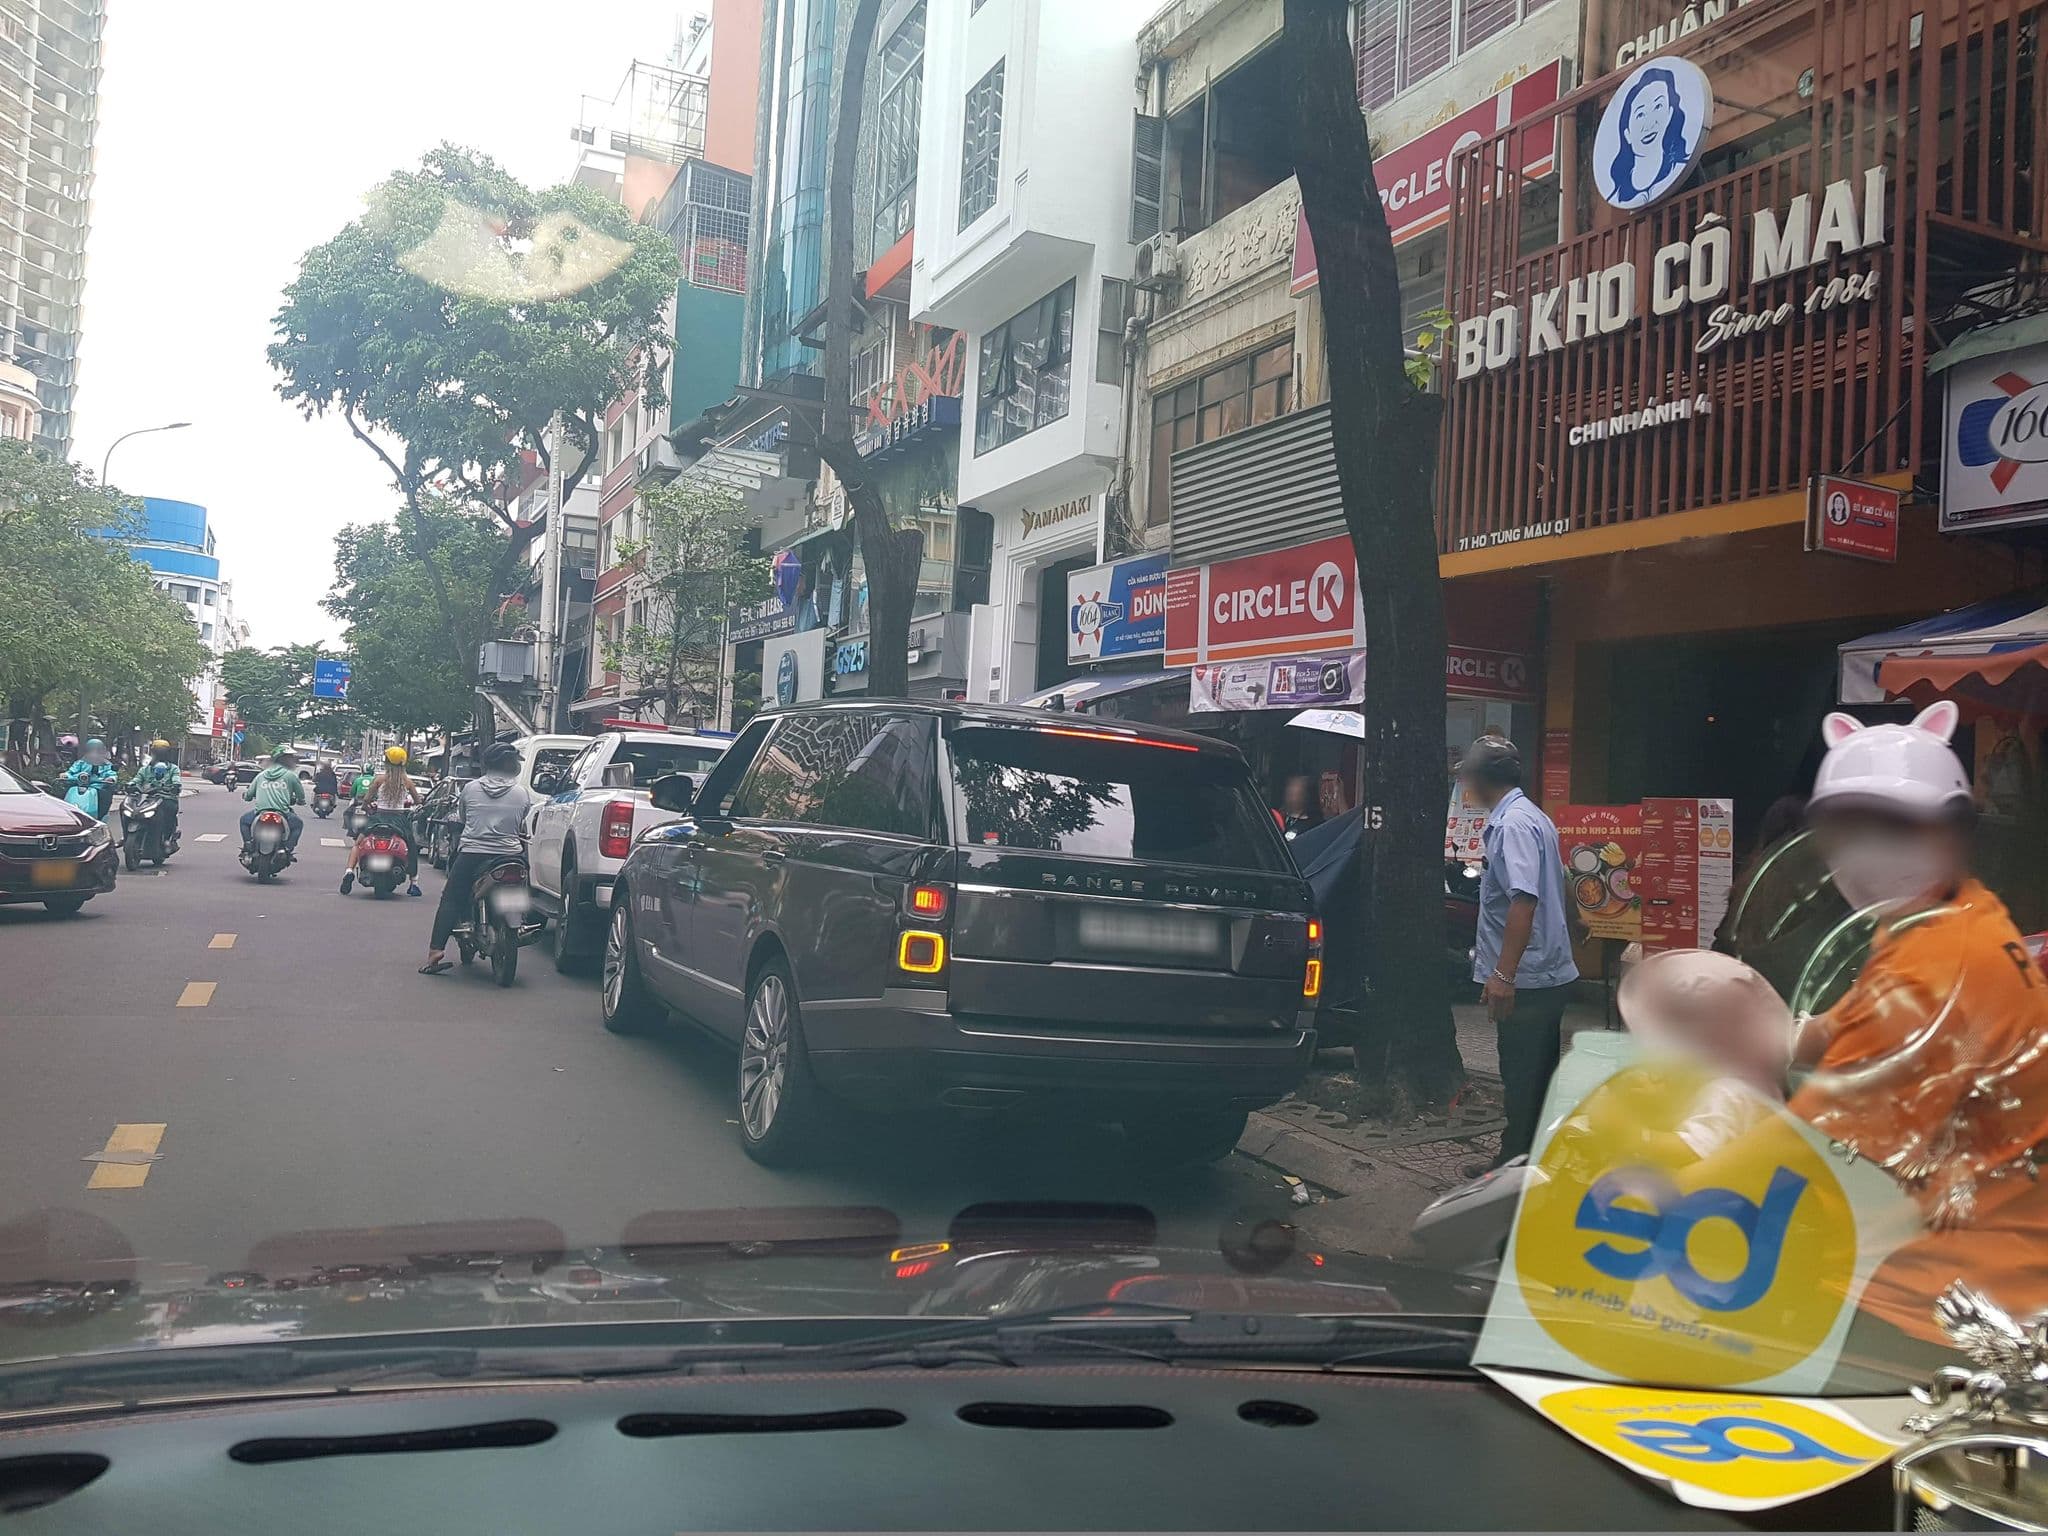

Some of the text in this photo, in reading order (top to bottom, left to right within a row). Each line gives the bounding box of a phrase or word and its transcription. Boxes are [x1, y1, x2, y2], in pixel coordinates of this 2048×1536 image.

[1457, 165, 1887, 381] BÒ KHO CÔ MAI
[1569, 393, 1712, 446] CHI NHÁNH 4
[1459, 537, 1469, 552] 71
[1214, 580, 1306, 624] CIRCLE
[1312, 564, 1343, 620] K
[836, 640, 866, 675] GS25
[1363, 805, 1383, 830] 15
[1581, 811, 1621, 825] NEW MENU
[1041, 873, 1257, 900] RANGE ROVER
